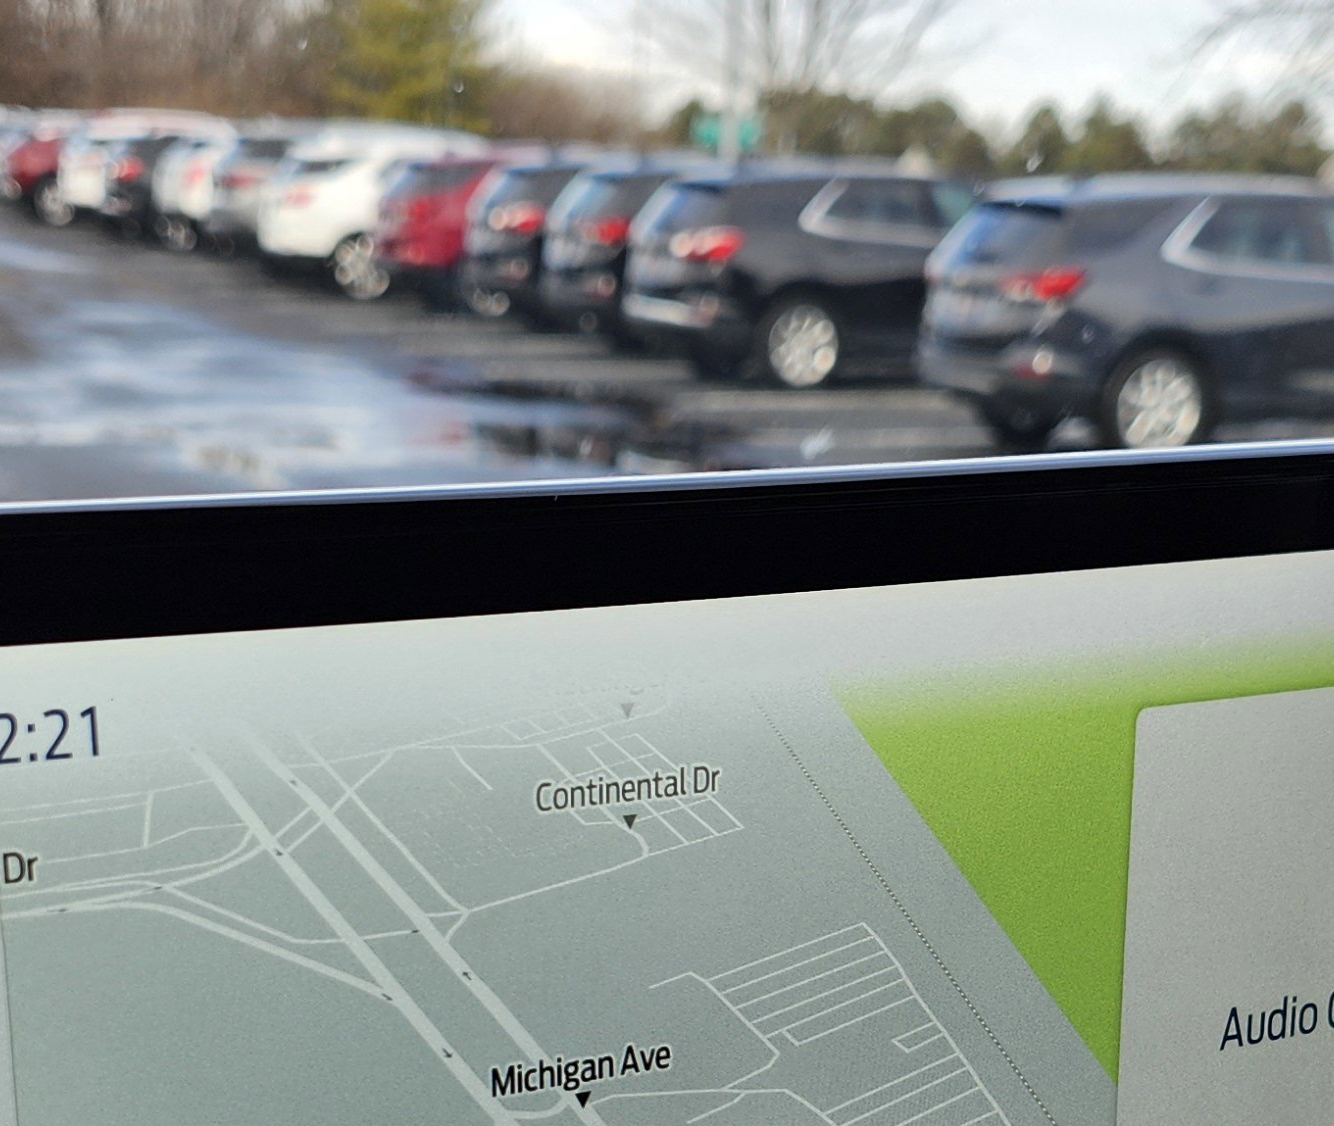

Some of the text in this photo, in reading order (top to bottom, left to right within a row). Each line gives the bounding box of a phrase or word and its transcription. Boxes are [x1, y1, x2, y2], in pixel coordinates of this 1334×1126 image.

[535, 765, 721, 812] Continental Dr
[2, 852, 39, 884] Dr
[1219, 995, 1318, 1051] Audio
[490, 1044, 672, 1098] Michigan Ave
